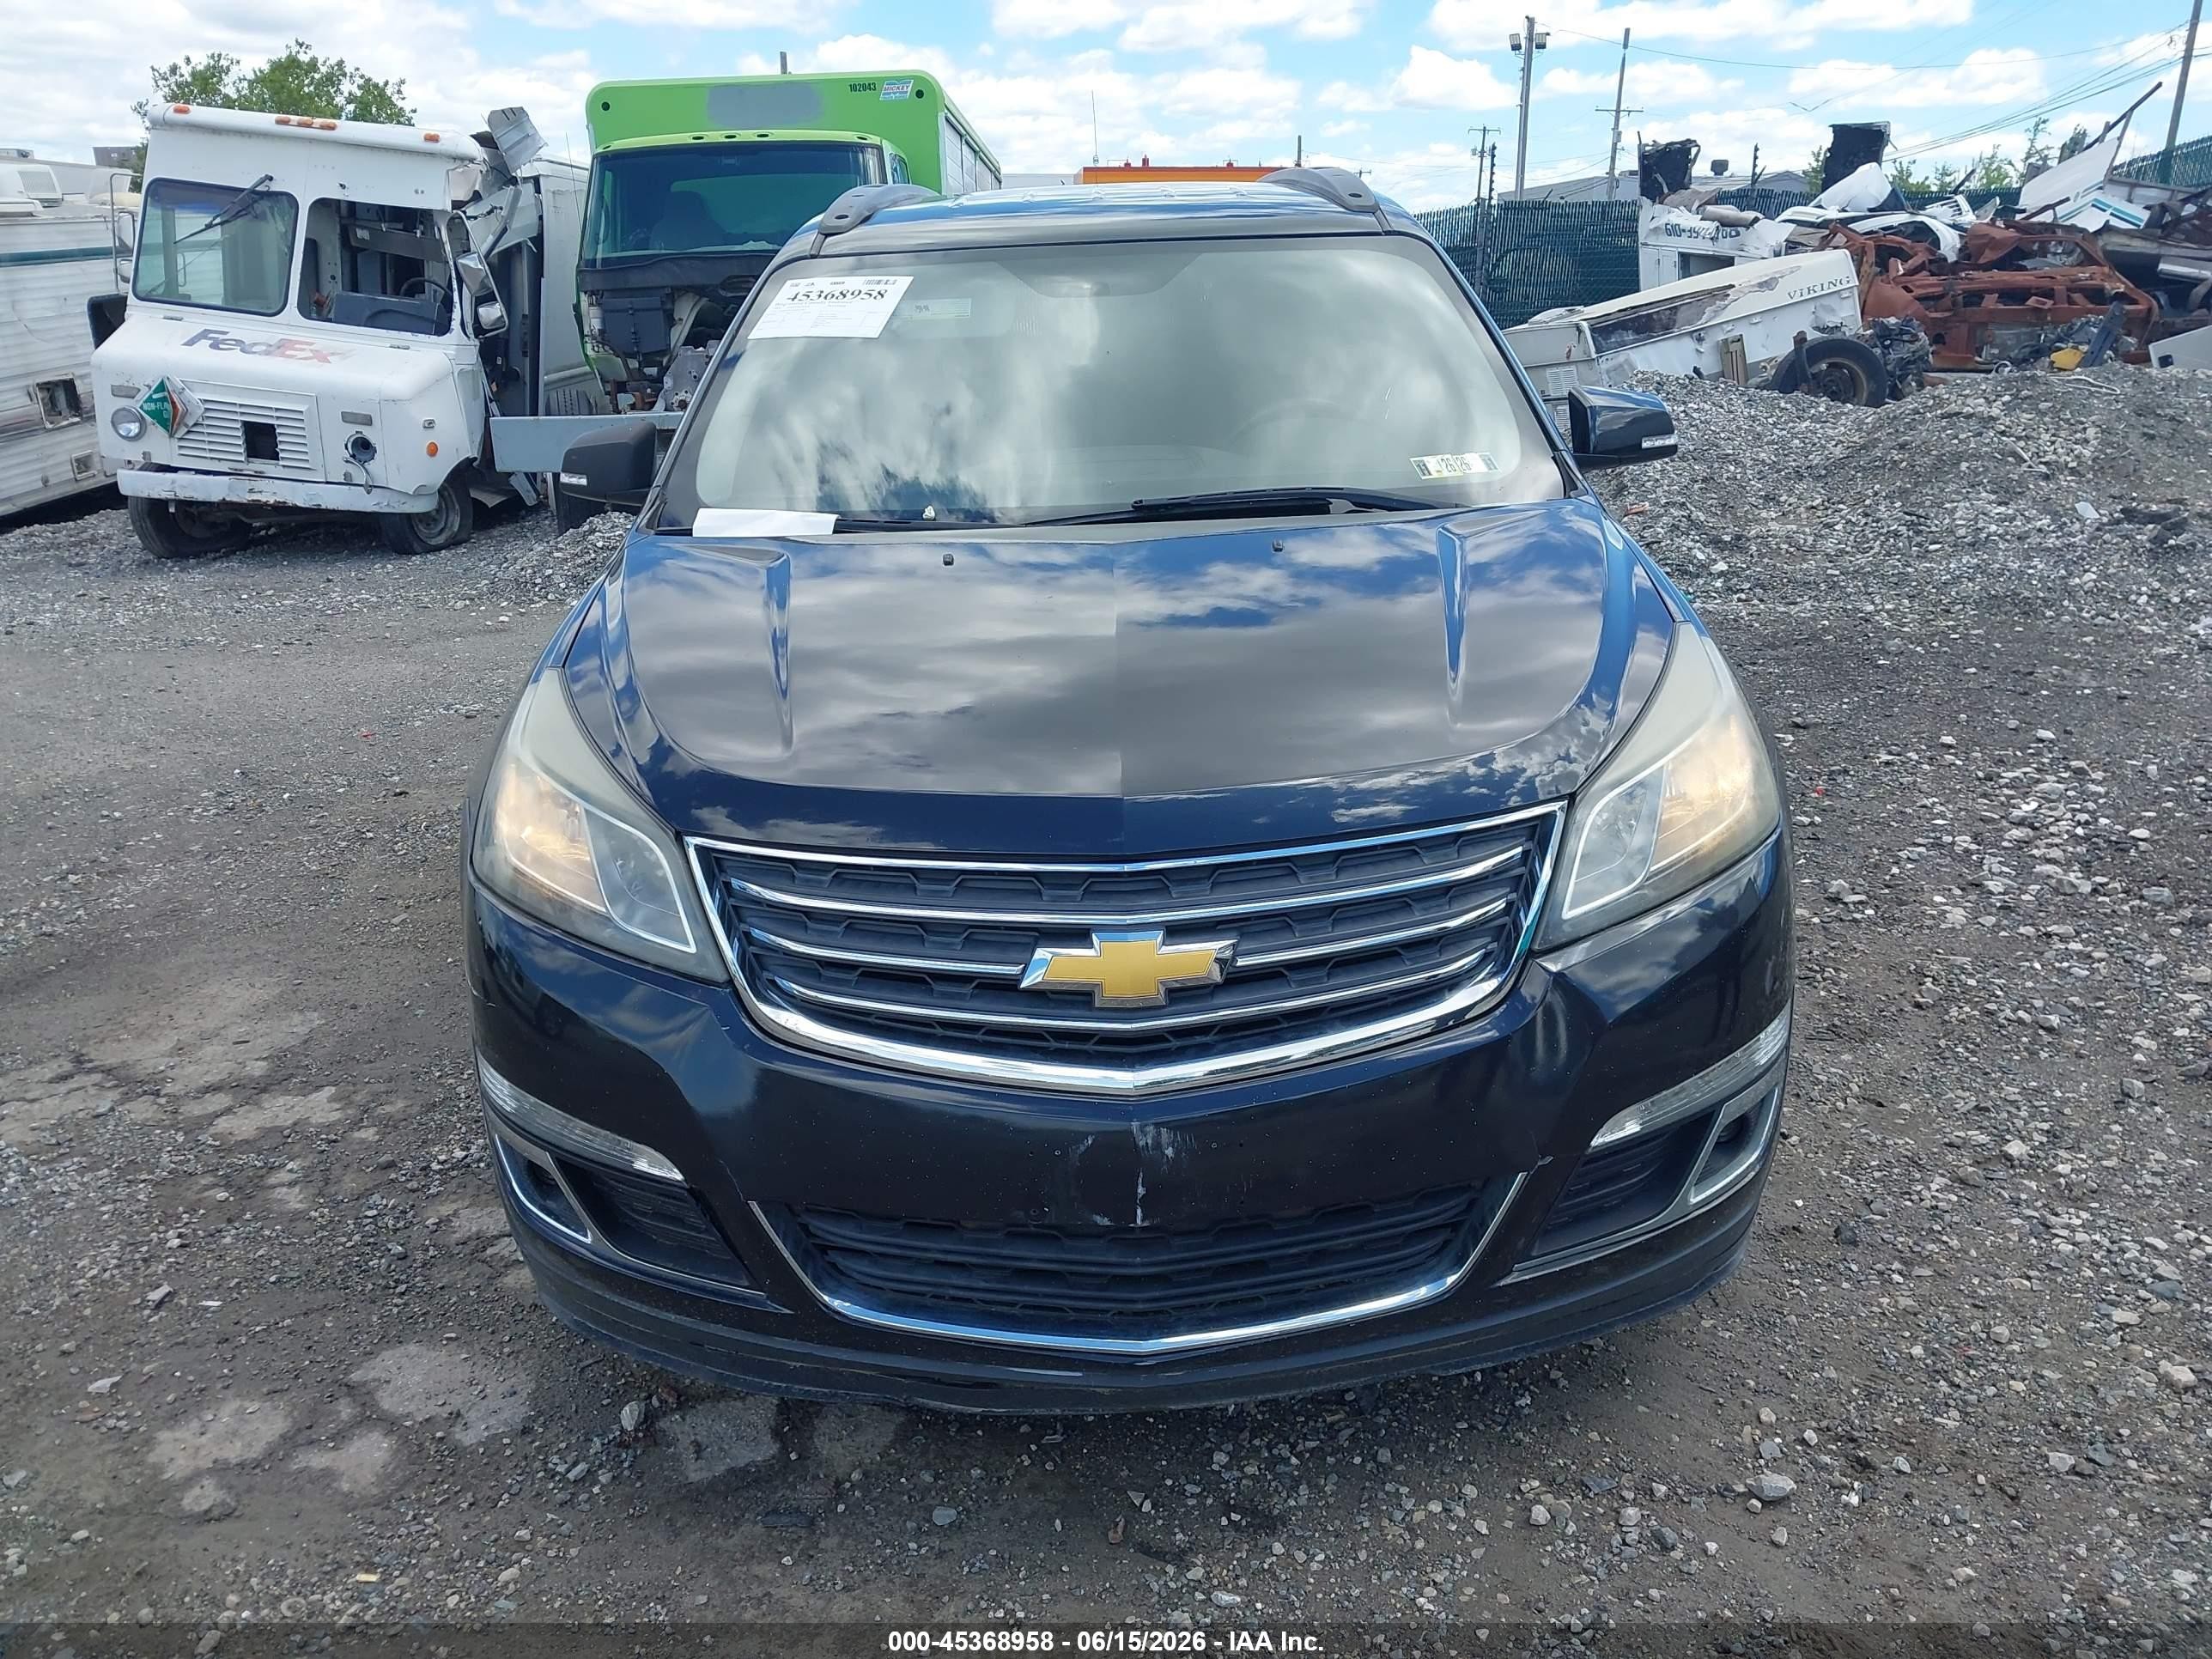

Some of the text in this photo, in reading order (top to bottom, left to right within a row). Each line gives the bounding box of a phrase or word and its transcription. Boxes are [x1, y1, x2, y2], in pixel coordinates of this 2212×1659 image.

[849, 82, 876, 92] 102043
[787, 289, 888, 301] 45368958
[1788, 276, 1850, 300] VIKING
[180, 328, 340, 364] FedEx
